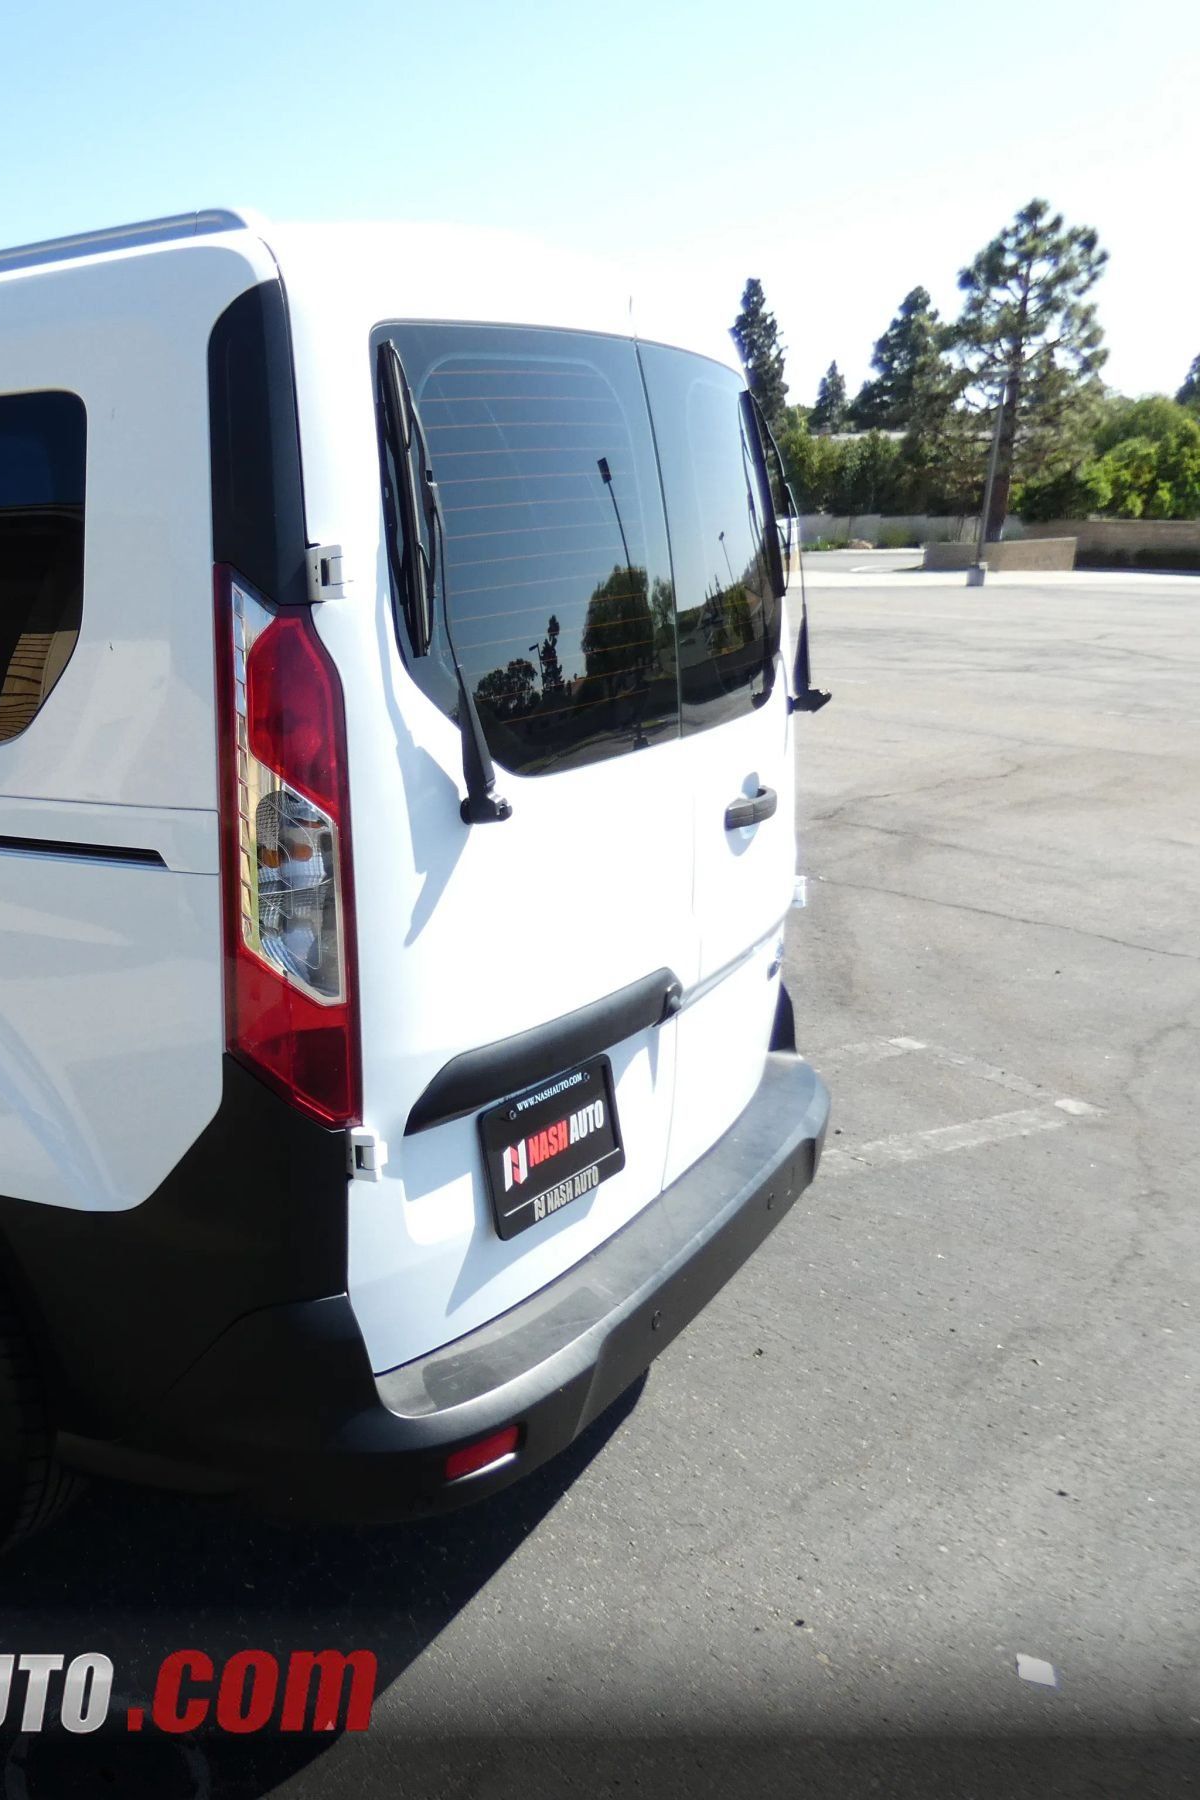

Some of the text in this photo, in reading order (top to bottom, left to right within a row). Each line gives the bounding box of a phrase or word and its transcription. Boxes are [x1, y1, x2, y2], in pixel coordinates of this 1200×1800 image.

[516, 1072, 582, 1112] WWW.NASHAUTO.COM
[528, 1120, 568, 1167] NASH
[570, 1100, 604, 1144] AUTO
[547, 1184, 574, 1213] NASH
[574, 1166, 599, 1196] AUTO
